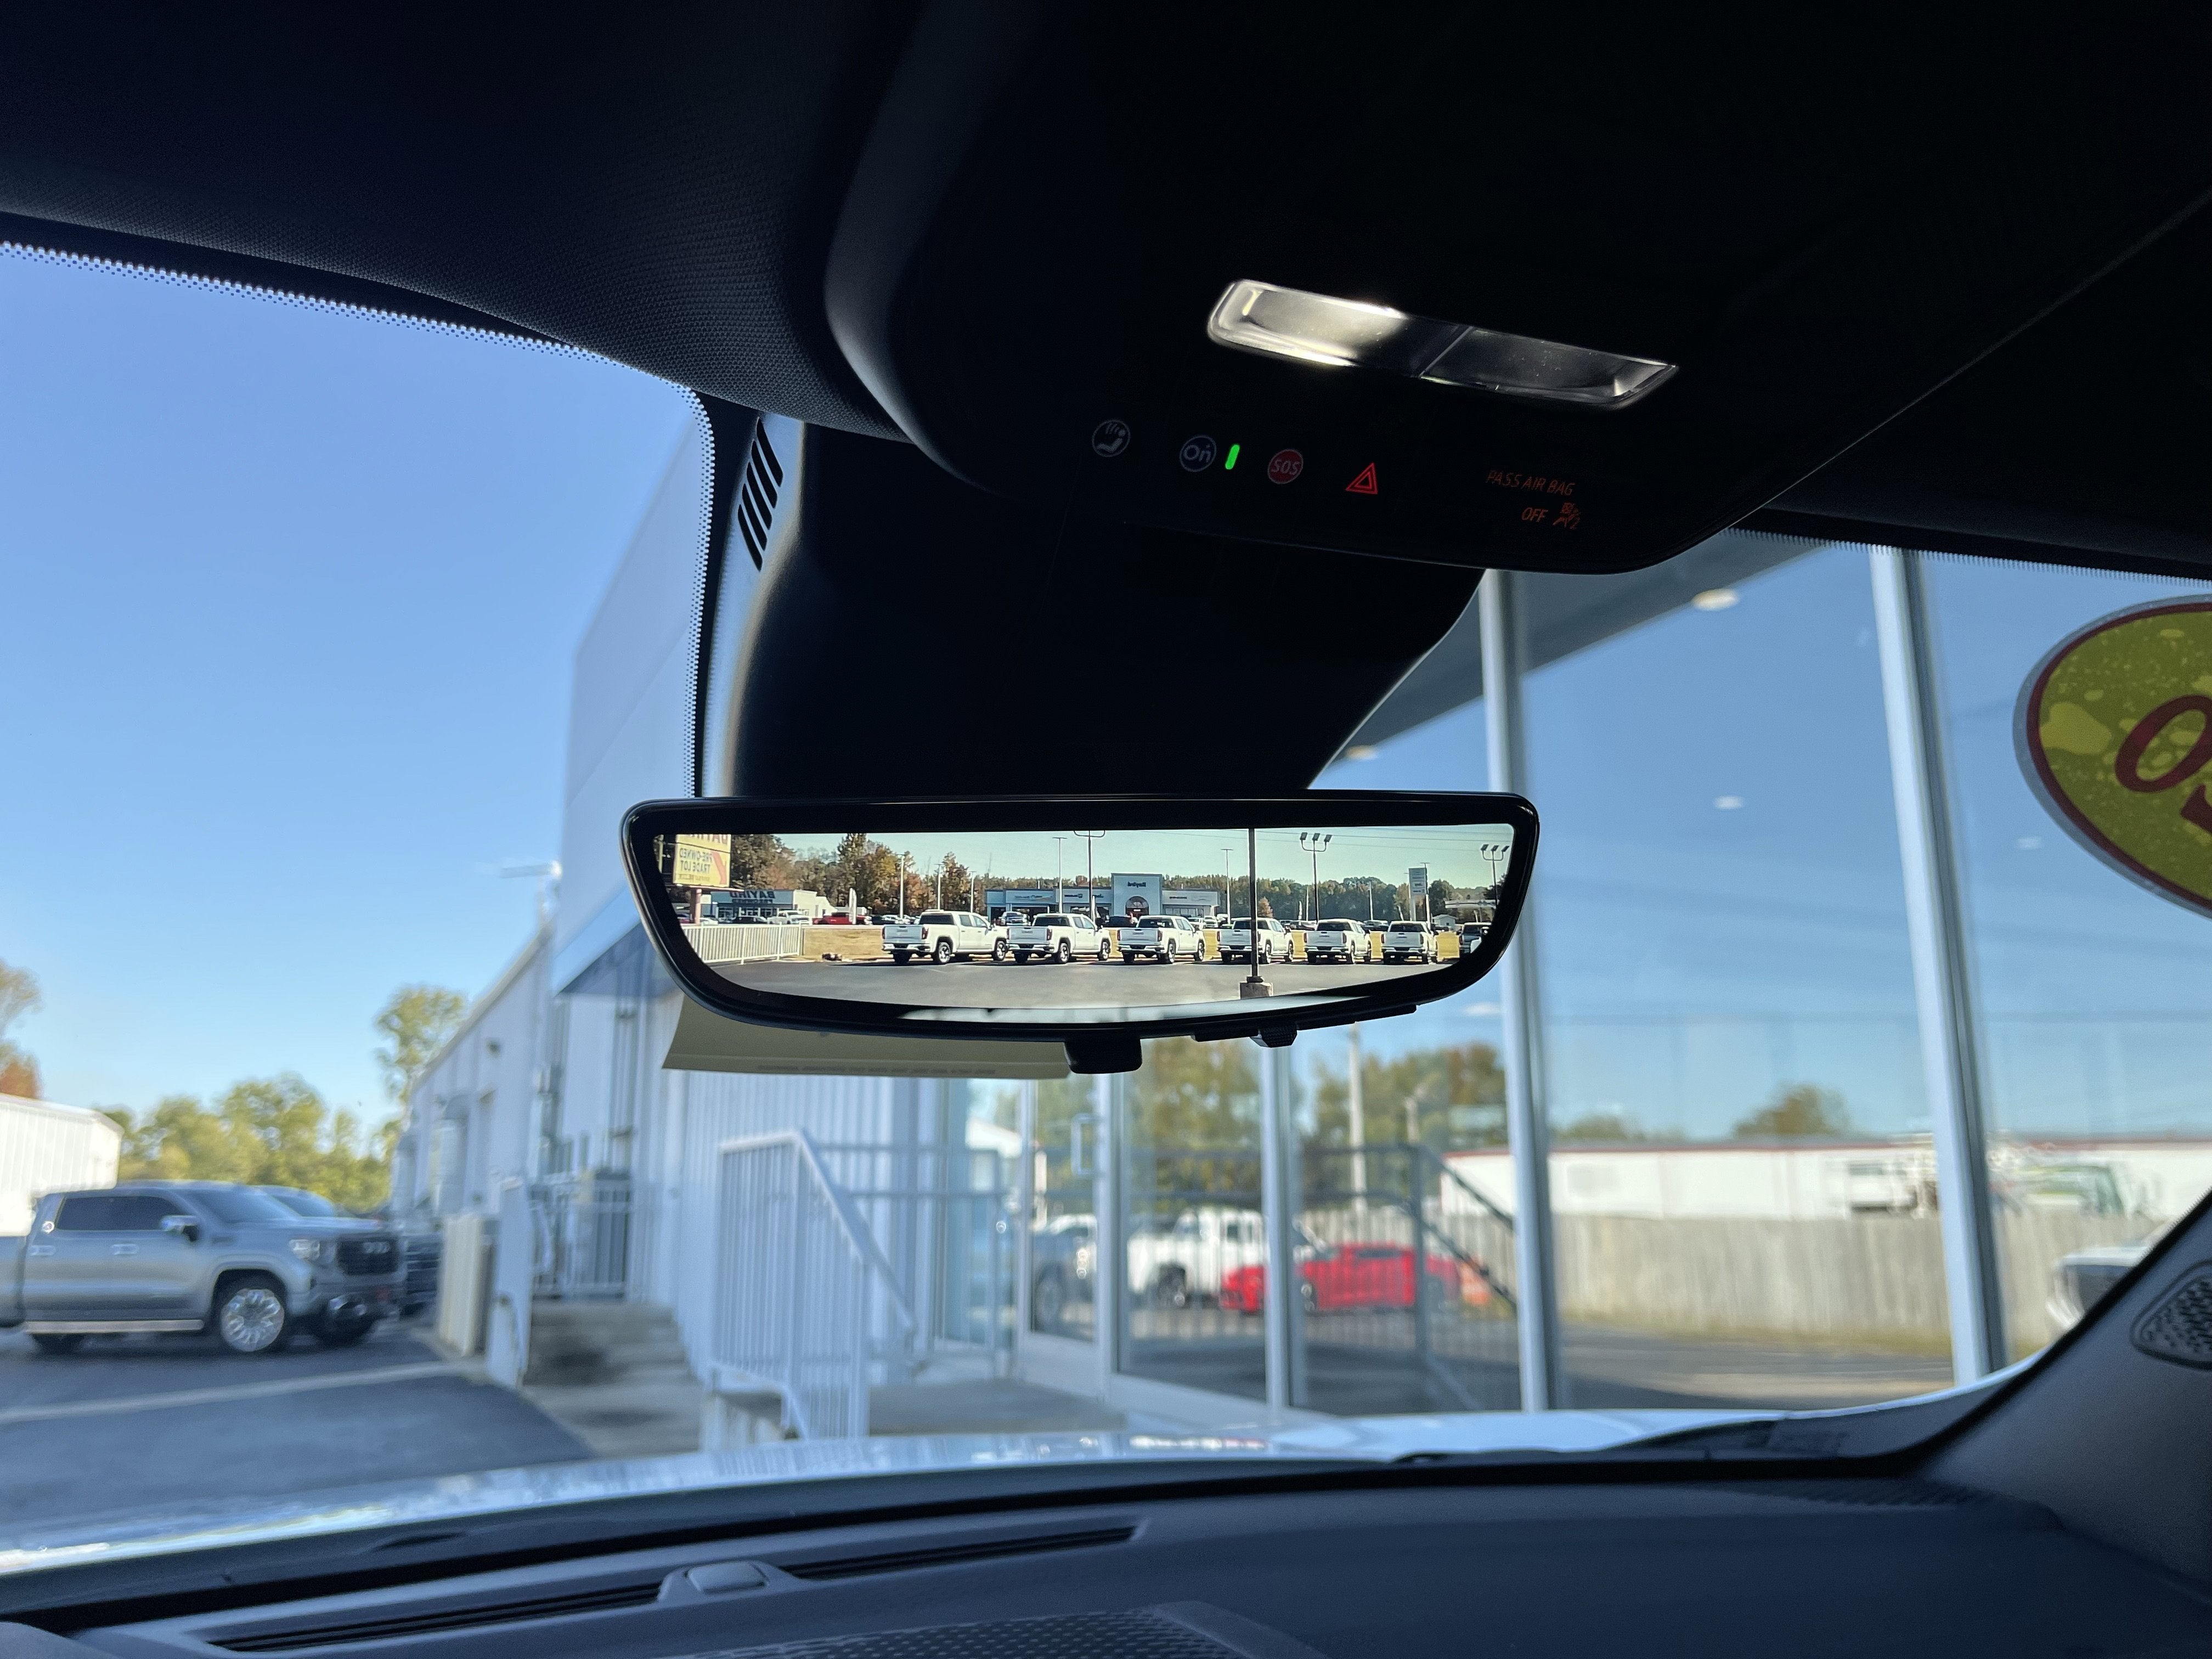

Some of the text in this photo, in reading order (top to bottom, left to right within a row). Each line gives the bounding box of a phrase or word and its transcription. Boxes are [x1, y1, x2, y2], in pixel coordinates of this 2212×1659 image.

[1271, 460, 1300, 475] SOS
[1485, 470, 1576, 495] PASS AIR BAG
[1521, 507, 1549, 522] OFF
